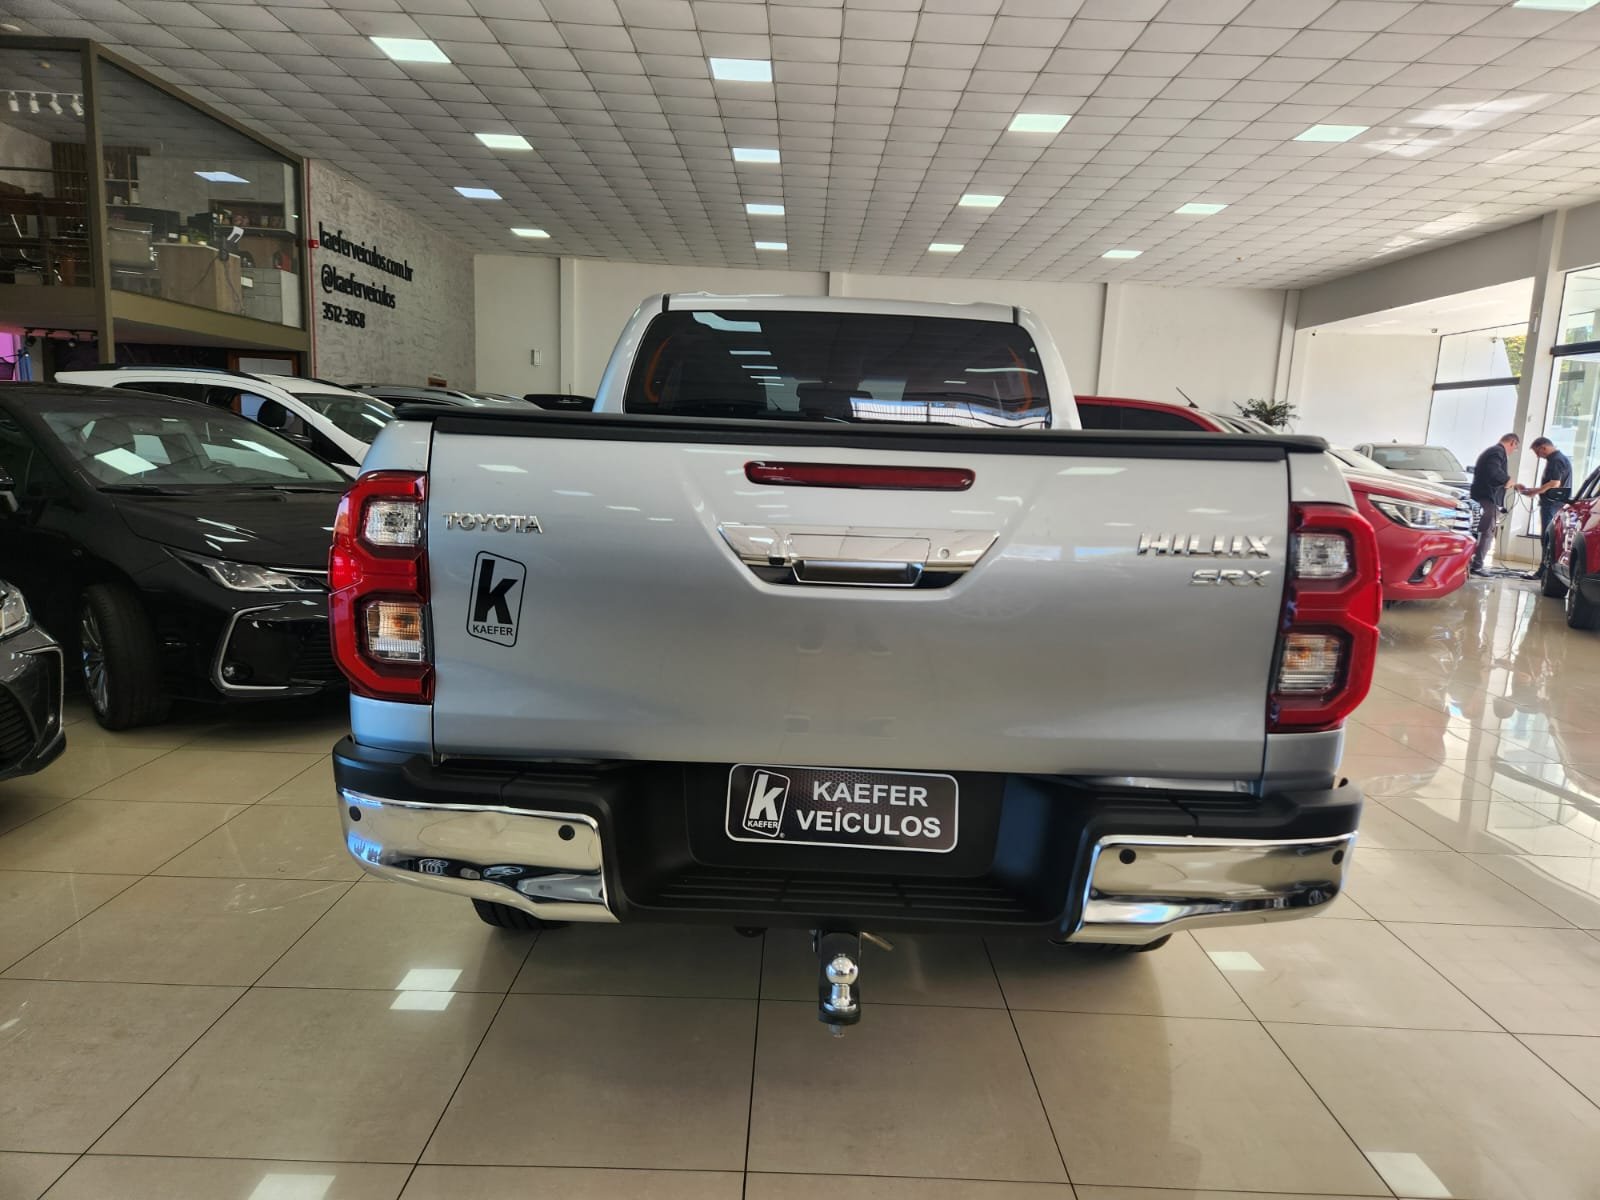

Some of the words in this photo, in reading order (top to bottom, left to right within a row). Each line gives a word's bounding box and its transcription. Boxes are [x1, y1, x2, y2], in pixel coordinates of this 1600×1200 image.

[318, 220, 414, 282] kaeferveiculos.com.br
[321, 263, 396, 309] @kaeferveiculos
[441, 511, 543, 534] TOYOTA
[1137, 531, 1273, 559] HILUX
[1189, 568, 1272, 588] SRX
[472, 623, 514, 637] KAEFER
[814, 780, 929, 808] KAEFER
[747, 819, 779, 830] KAEFER
[796, 806, 942, 839] VEÍCULOS
